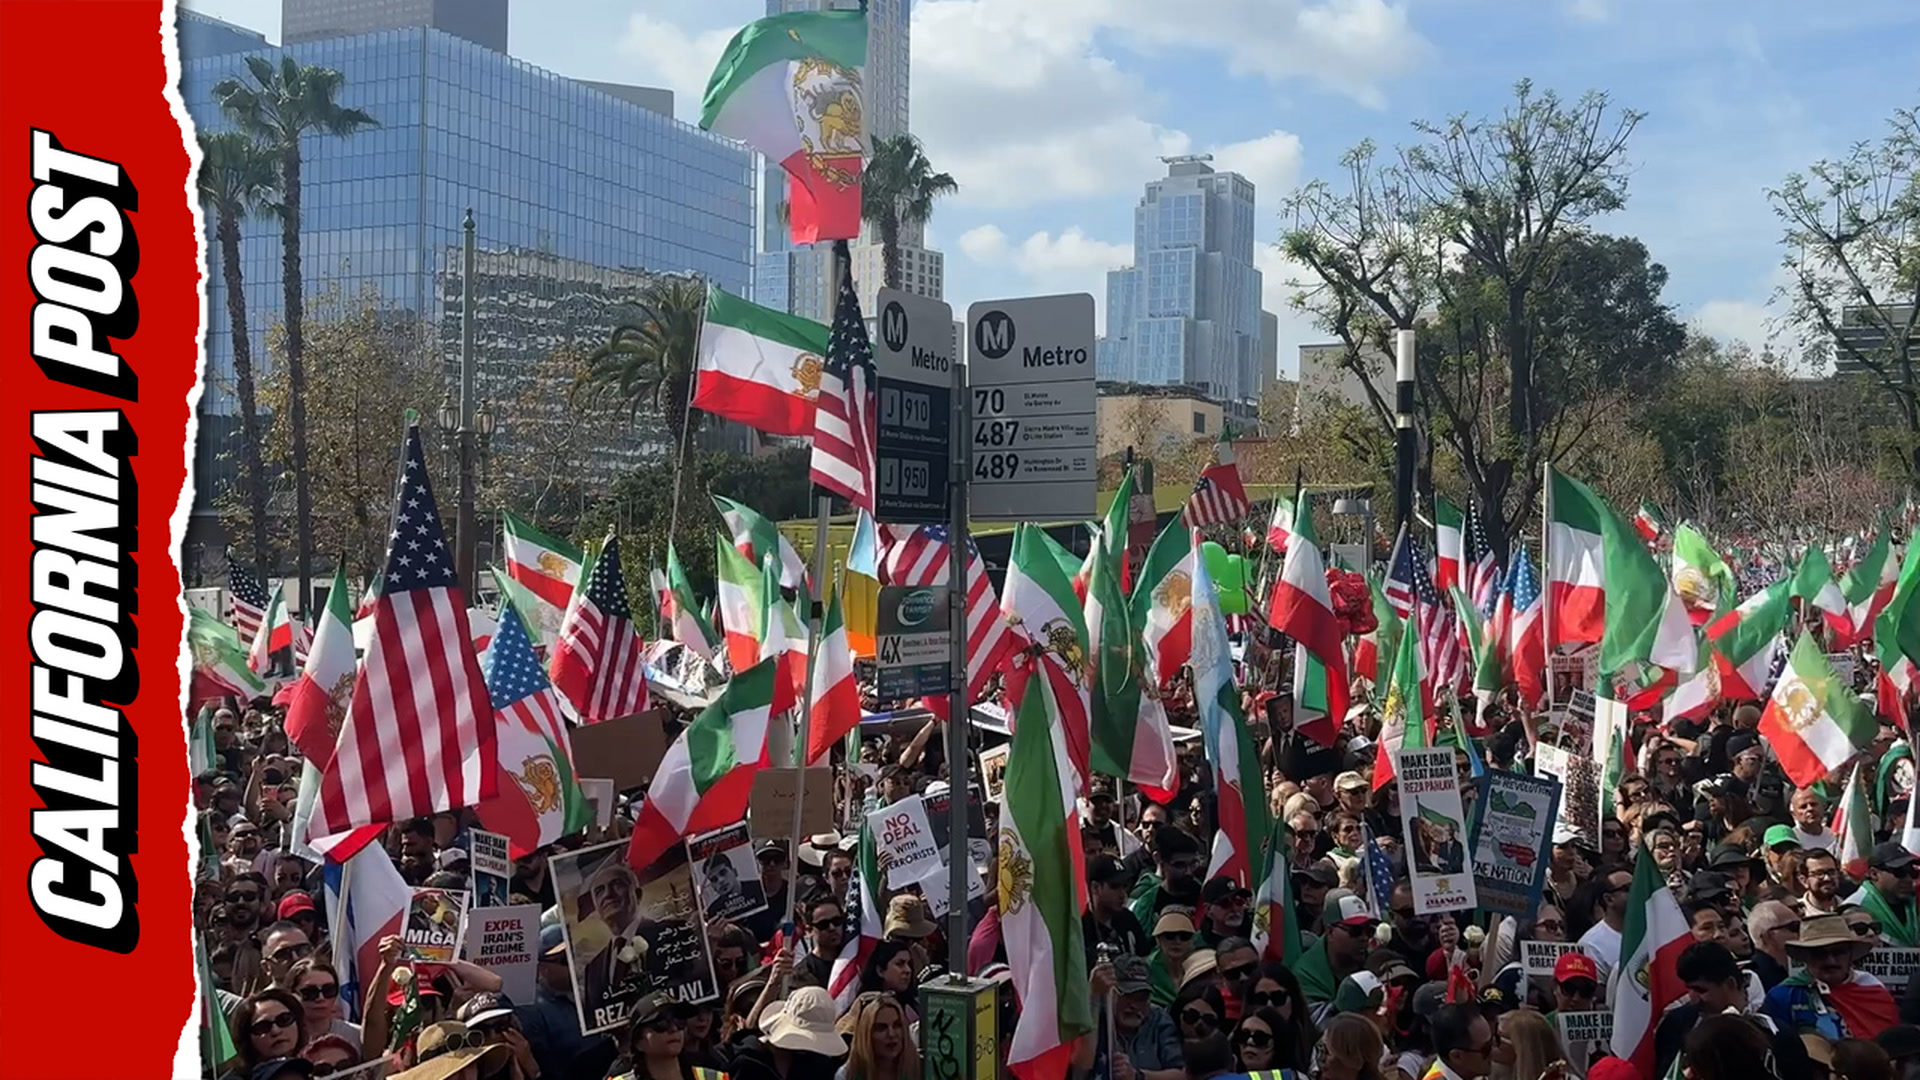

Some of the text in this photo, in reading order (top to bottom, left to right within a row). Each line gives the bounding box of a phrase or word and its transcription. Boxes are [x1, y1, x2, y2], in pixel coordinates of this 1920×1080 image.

[911, 345, 949, 373] Metro
[1023, 346, 1087, 368] Metro
[887, 395, 928, 422] J 910
[975, 389, 1005, 415] 70
[974, 421, 1019, 447] 487
[974, 453, 1019, 480] 489
[885, 464, 927, 489] J 950
[880, 636, 902, 664] 4X
[1400, 752, 1451, 769] MAKE IRAN
[1402, 766, 1454, 781] GREAT AGAIN
[1403, 778, 1456, 795] REZA PAHLAVI
[1502, 778, 1553, 796] REVOLUTION
[885, 813, 910, 831] NO
[883, 823, 921, 845] DEAL
[894, 840, 919, 854] WITH
[885, 847, 937, 871] TERRORISTS
[1490, 864, 1532, 884] NATION
[484, 919, 524, 932] EXPEL
[406, 928, 455, 946] MIGA
[483, 931, 524, 944] IRAN'S
[481, 942, 525, 956] REGIME
[1527, 944, 1557, 956] MAKE
[473, 953, 531, 967] DIPLOMATS
[1528, 957, 1556, 968] GREAT
[1892, 952, 1920, 965] IRAN
[1864, 965, 1917, 976] REAT AGAI
[1565, 1013, 1613, 1028] MAKE IR
[1567, 1028, 1598, 1041] GREAT
